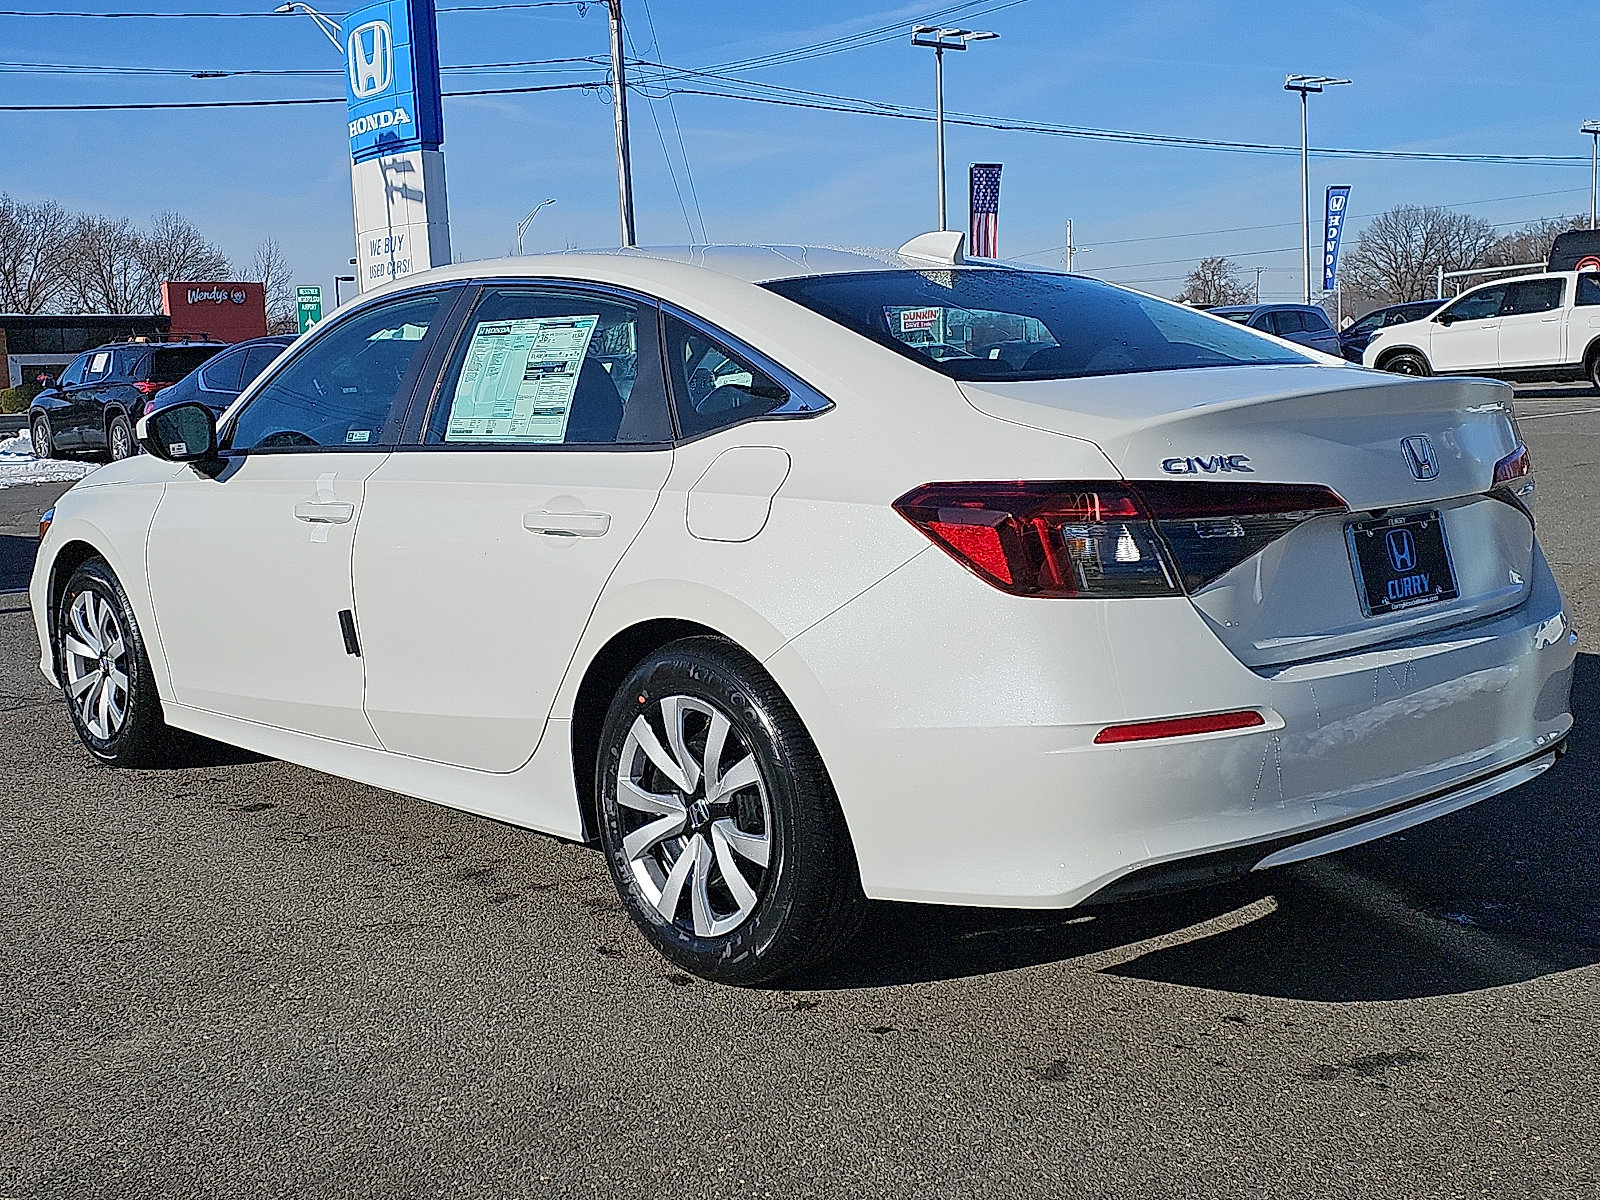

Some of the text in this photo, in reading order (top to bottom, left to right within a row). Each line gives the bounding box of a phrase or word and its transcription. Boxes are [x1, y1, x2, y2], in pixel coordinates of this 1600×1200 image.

[347, 107, 412, 139] HONDA
[370, 234, 404, 256] WE BUY
[1325, 215, 1342, 278] HONDA
[369, 258, 410, 279] USED CARS!
[903, 309, 939, 321] DUNKIN'
[484, 326, 511, 335] HONDA
[1161, 454, 1255, 474] CIVIC
[1387, 573, 1430, 601] CURRY
